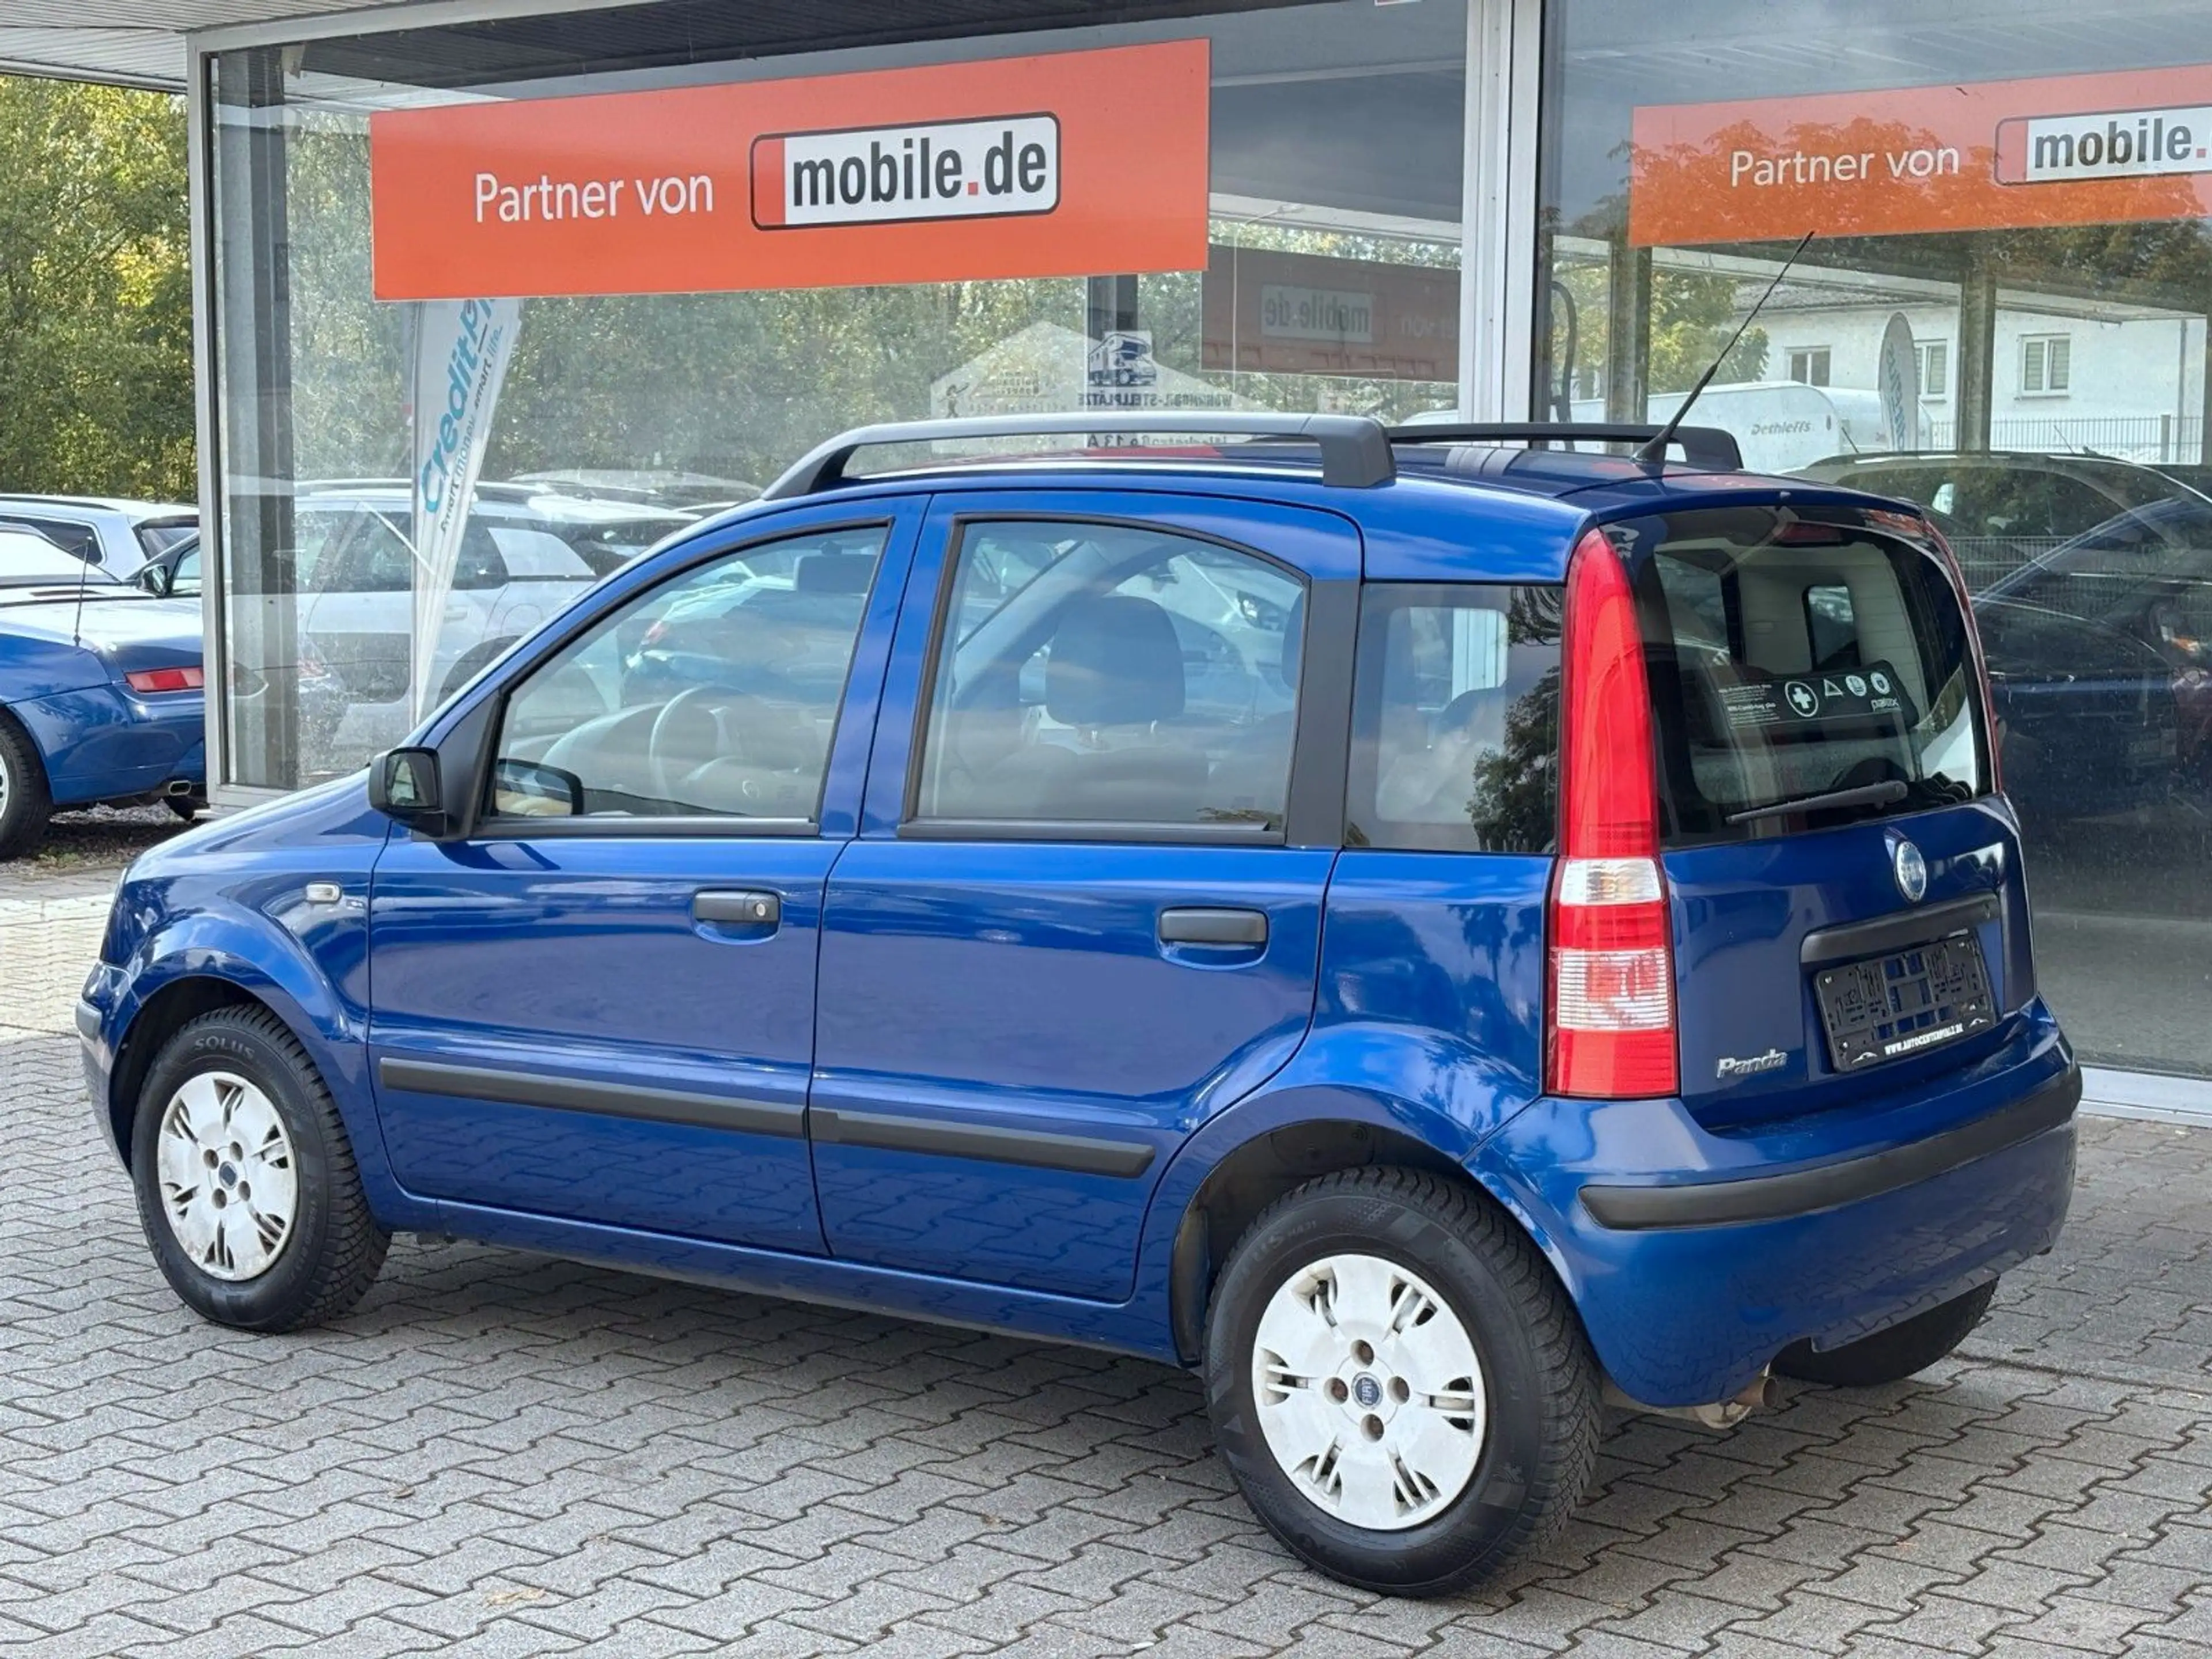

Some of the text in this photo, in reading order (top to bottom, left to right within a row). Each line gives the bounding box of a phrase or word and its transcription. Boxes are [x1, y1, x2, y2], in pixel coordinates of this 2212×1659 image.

[474, 131, 1047, 223] Partner von mobile.de
[1730, 149, 1876, 188] Partner
[1887, 146, 1959, 177] von
[195, 1036, 255, 1060] SOLUS
[1716, 1048, 1787, 1079] Panda
